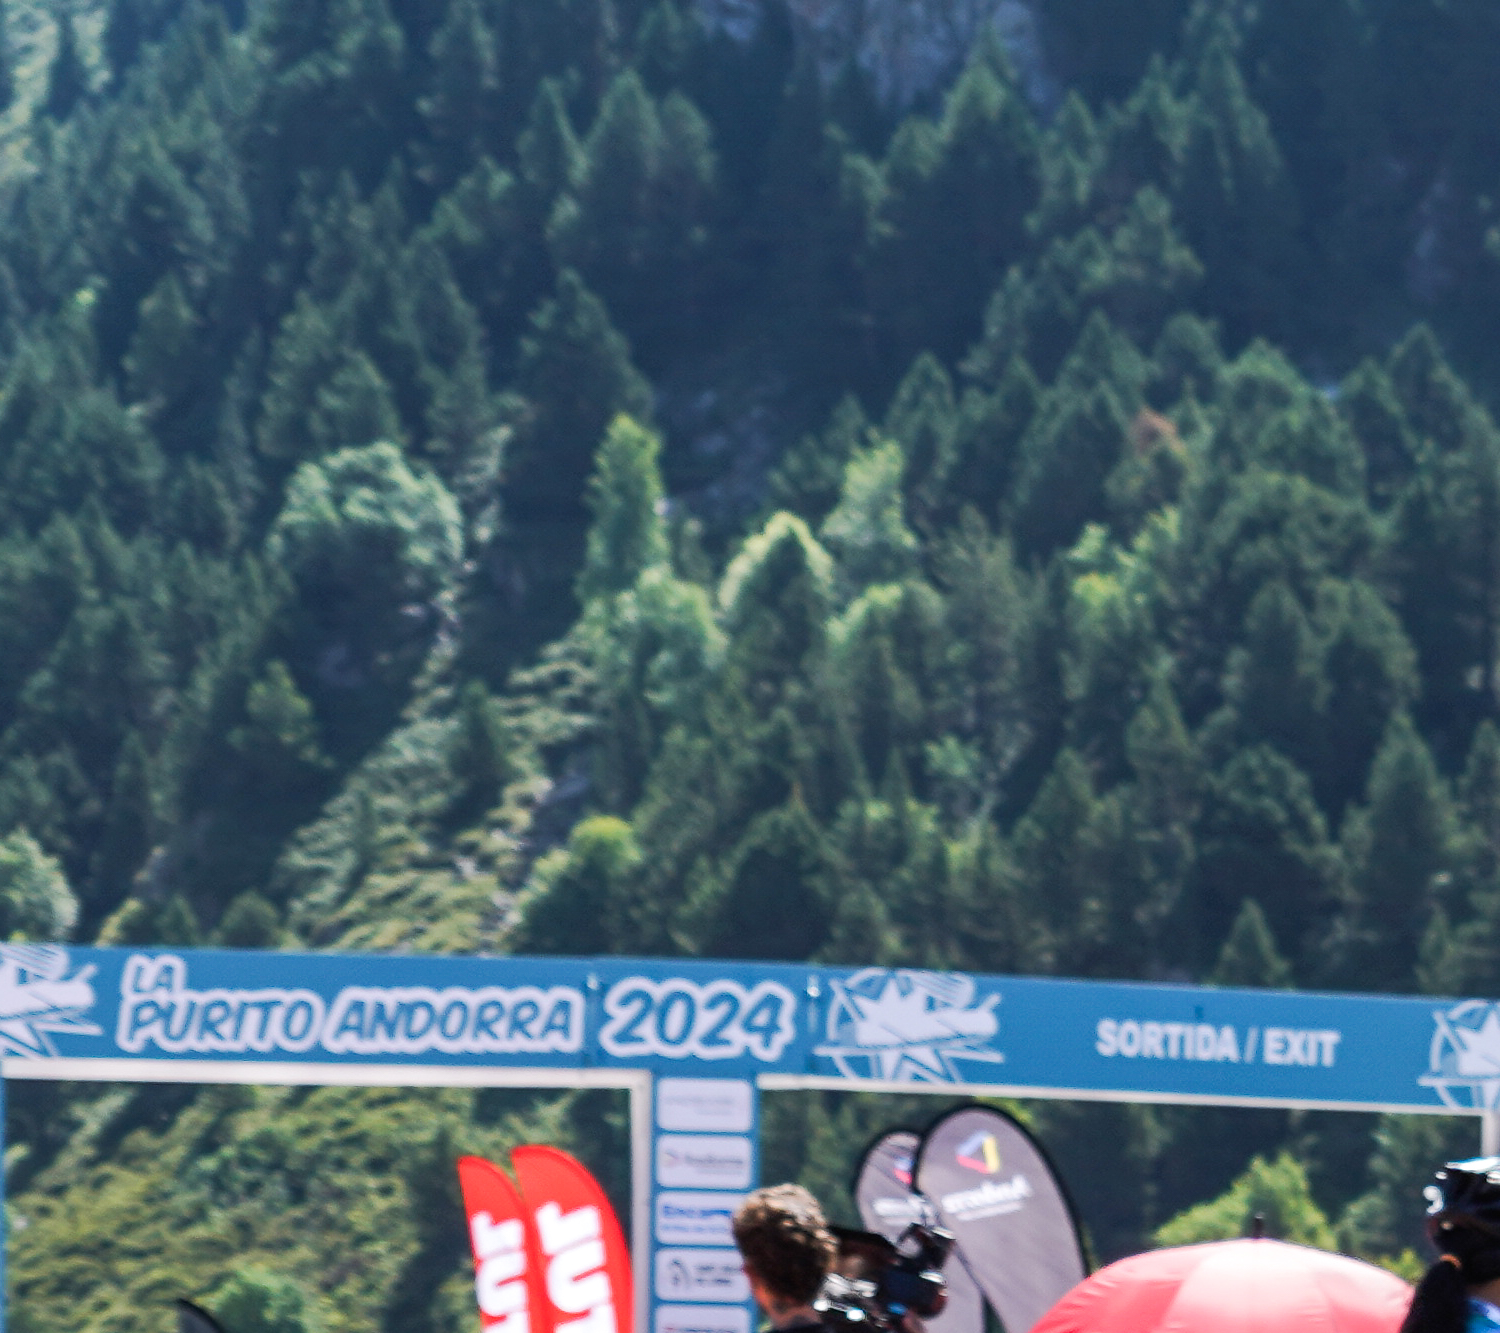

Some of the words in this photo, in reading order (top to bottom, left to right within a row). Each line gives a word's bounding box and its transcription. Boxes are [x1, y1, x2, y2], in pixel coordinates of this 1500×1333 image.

[125, 955, 182, 998] LA
[121, 992, 322, 1051] PURITO
[327, 992, 583, 1052] ANDORRA
[604, 981, 794, 1057] 2024
[1097, 1020, 1239, 1063] SORTIDA
[1264, 1028, 1340, 1067] EXIT
